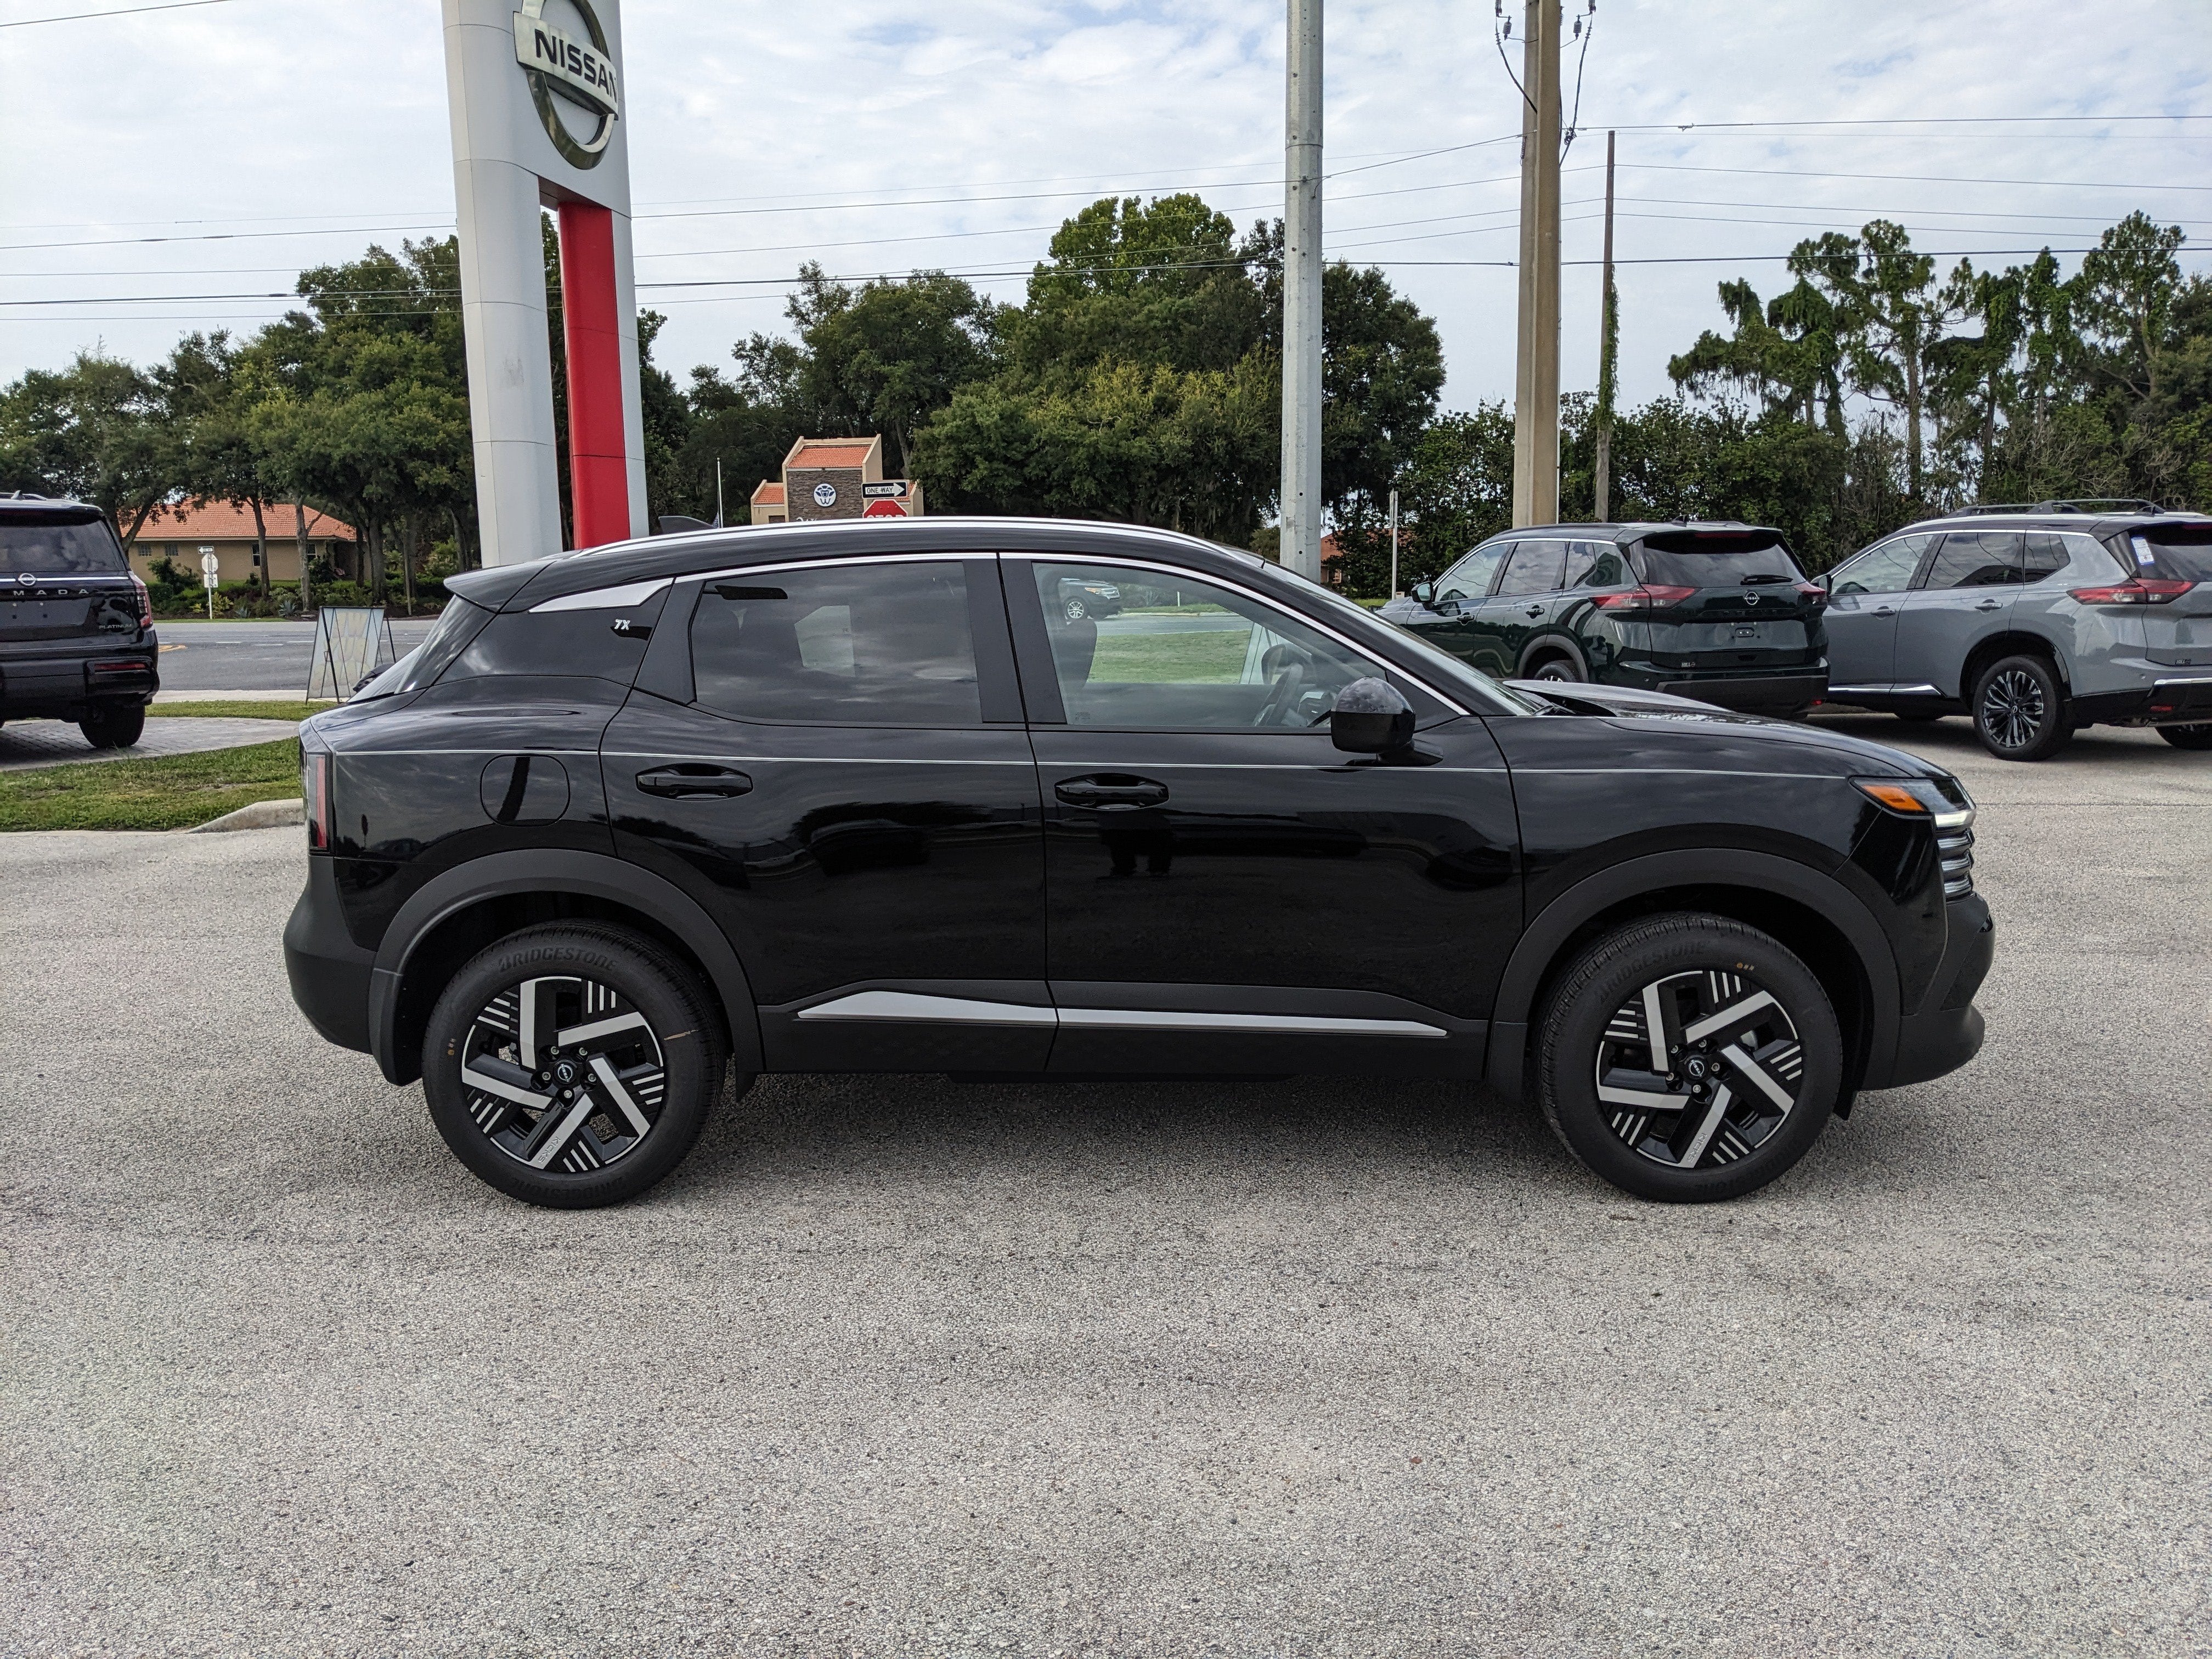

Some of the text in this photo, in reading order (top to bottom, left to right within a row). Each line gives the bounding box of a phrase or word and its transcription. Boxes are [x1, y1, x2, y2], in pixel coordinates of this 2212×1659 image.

[534, 29, 618, 103] NISSAN
[614, 619, 630, 630] 7X
[498, 947, 619, 972] BRIDGESTONE
[537, 1136, 561, 1164] KICKS
